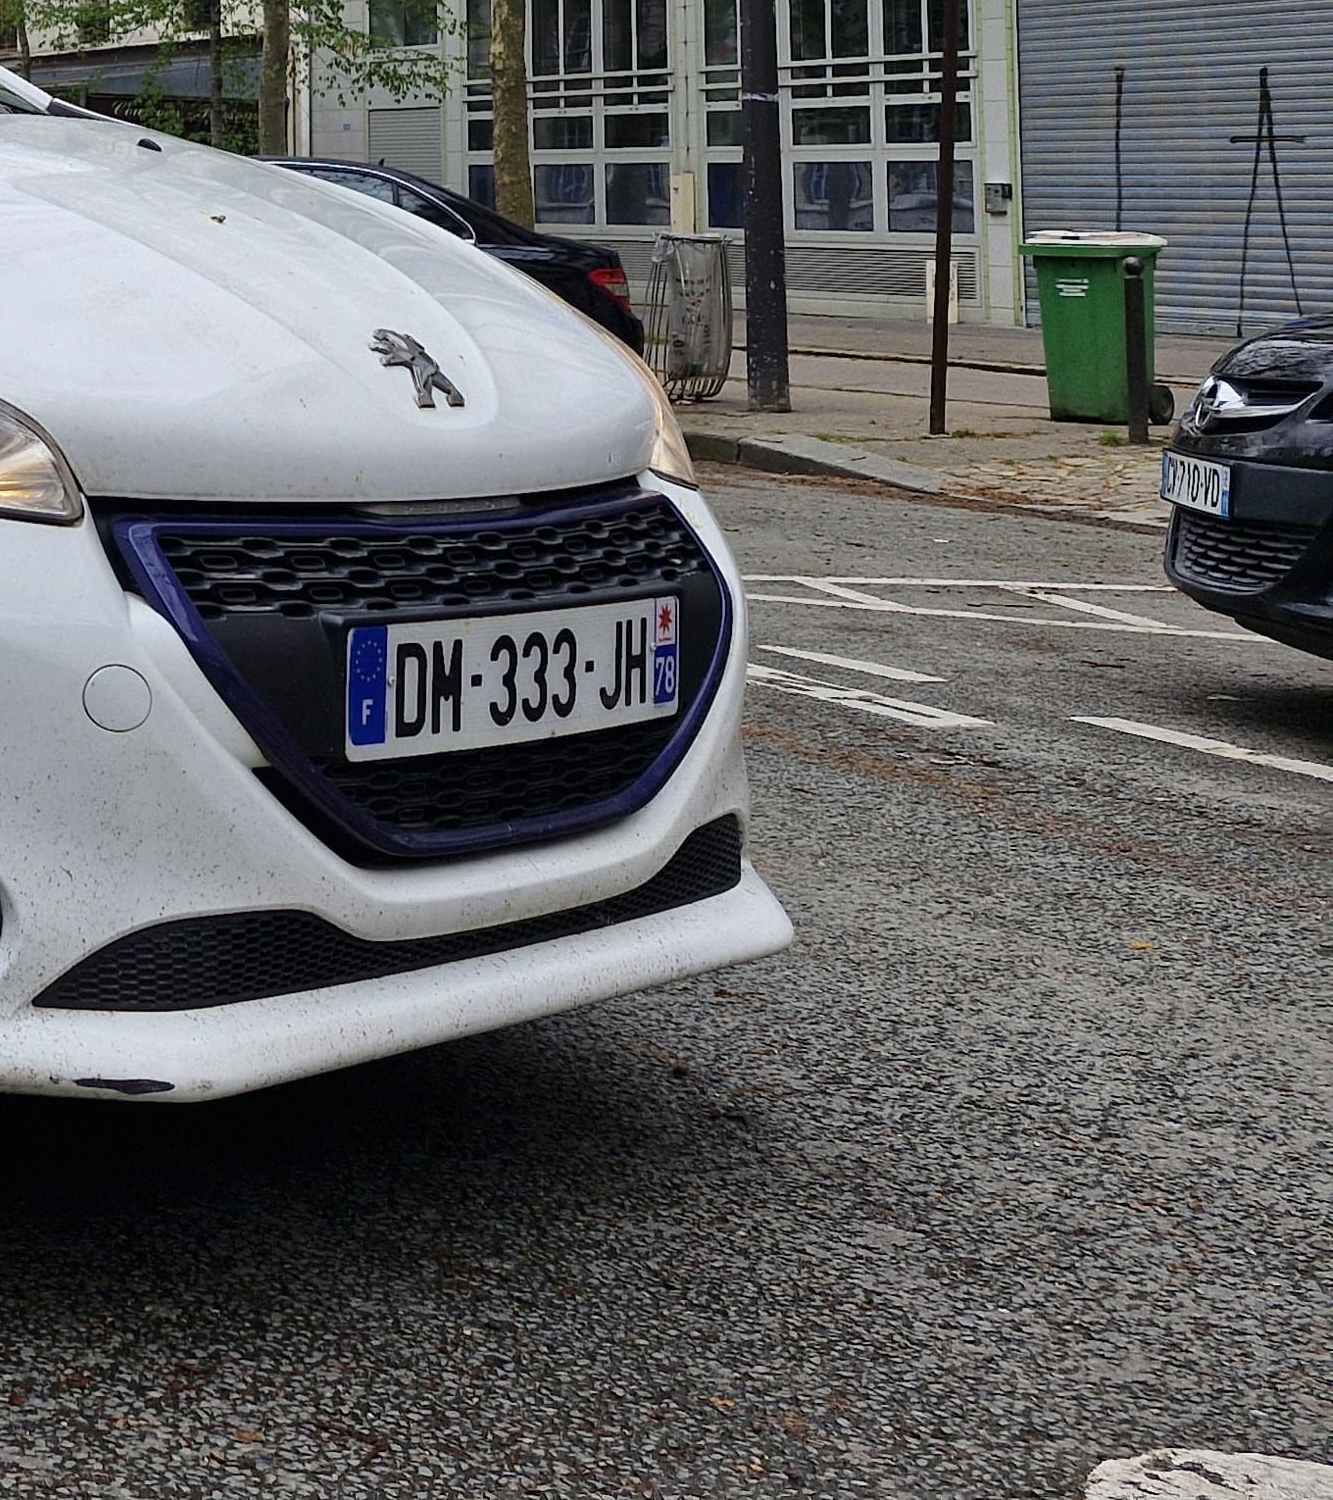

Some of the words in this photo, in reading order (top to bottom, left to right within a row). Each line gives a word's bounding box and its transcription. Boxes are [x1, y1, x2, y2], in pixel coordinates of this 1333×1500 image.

[394, 617, 648, 739] DM-333-JH
[655, 655, 675, 696] 78
[361, 699, 373, 726] F
